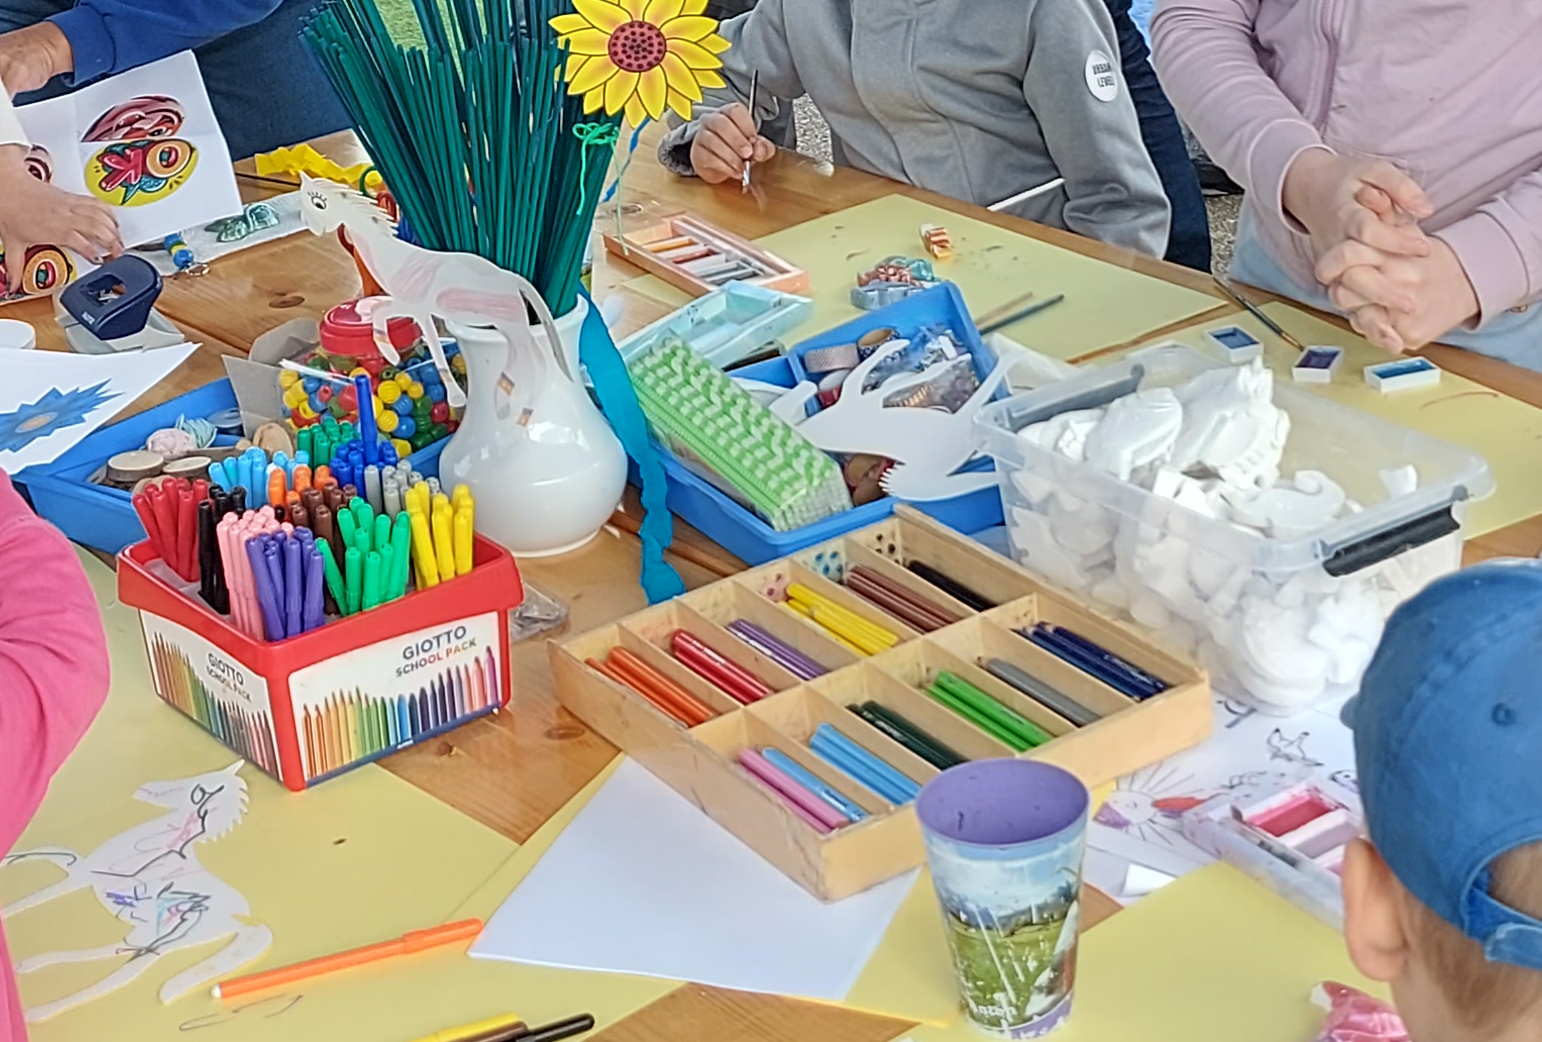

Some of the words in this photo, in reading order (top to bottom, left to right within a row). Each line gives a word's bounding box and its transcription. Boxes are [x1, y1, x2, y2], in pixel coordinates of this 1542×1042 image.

[395, 652, 443, 678] SCHOOL
[445, 637, 477, 658] PACK
[402, 625, 467, 660] GIOTTO
[208, 653, 244, 686] GIOTTO
